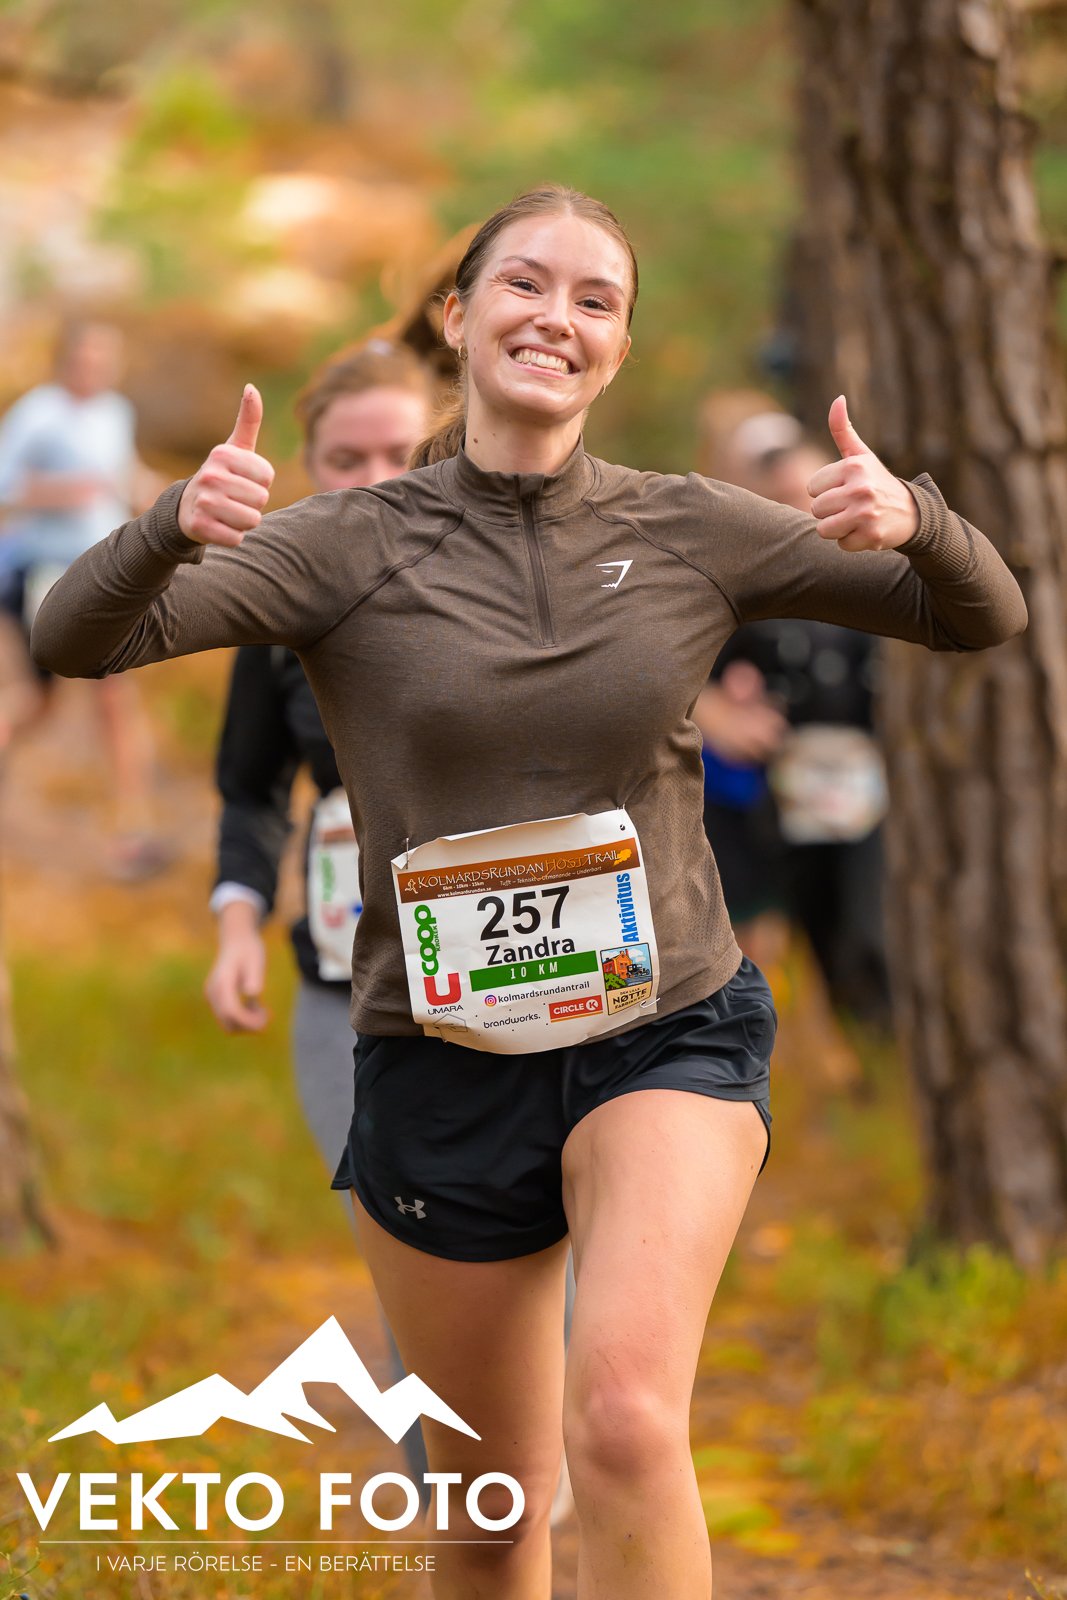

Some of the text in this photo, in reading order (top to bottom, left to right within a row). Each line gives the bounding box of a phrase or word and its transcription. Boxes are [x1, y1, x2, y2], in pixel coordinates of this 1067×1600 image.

[476, 885, 570, 941] 257
[616, 872, 639, 943] Aktivitus
[414, 904, 439, 976] coop
[486, 935, 575, 966] Zandra
[510, 962, 559, 980] 10 KM
[498, 981, 590, 1004] kolmardsrundantrail
[613, 987, 647, 1005] NØTTE
[427, 1004, 464, 1015] UMARA
[553, 1004, 584, 1016] CIRCLE
[483, 1012, 541, 1029] brandworks.
